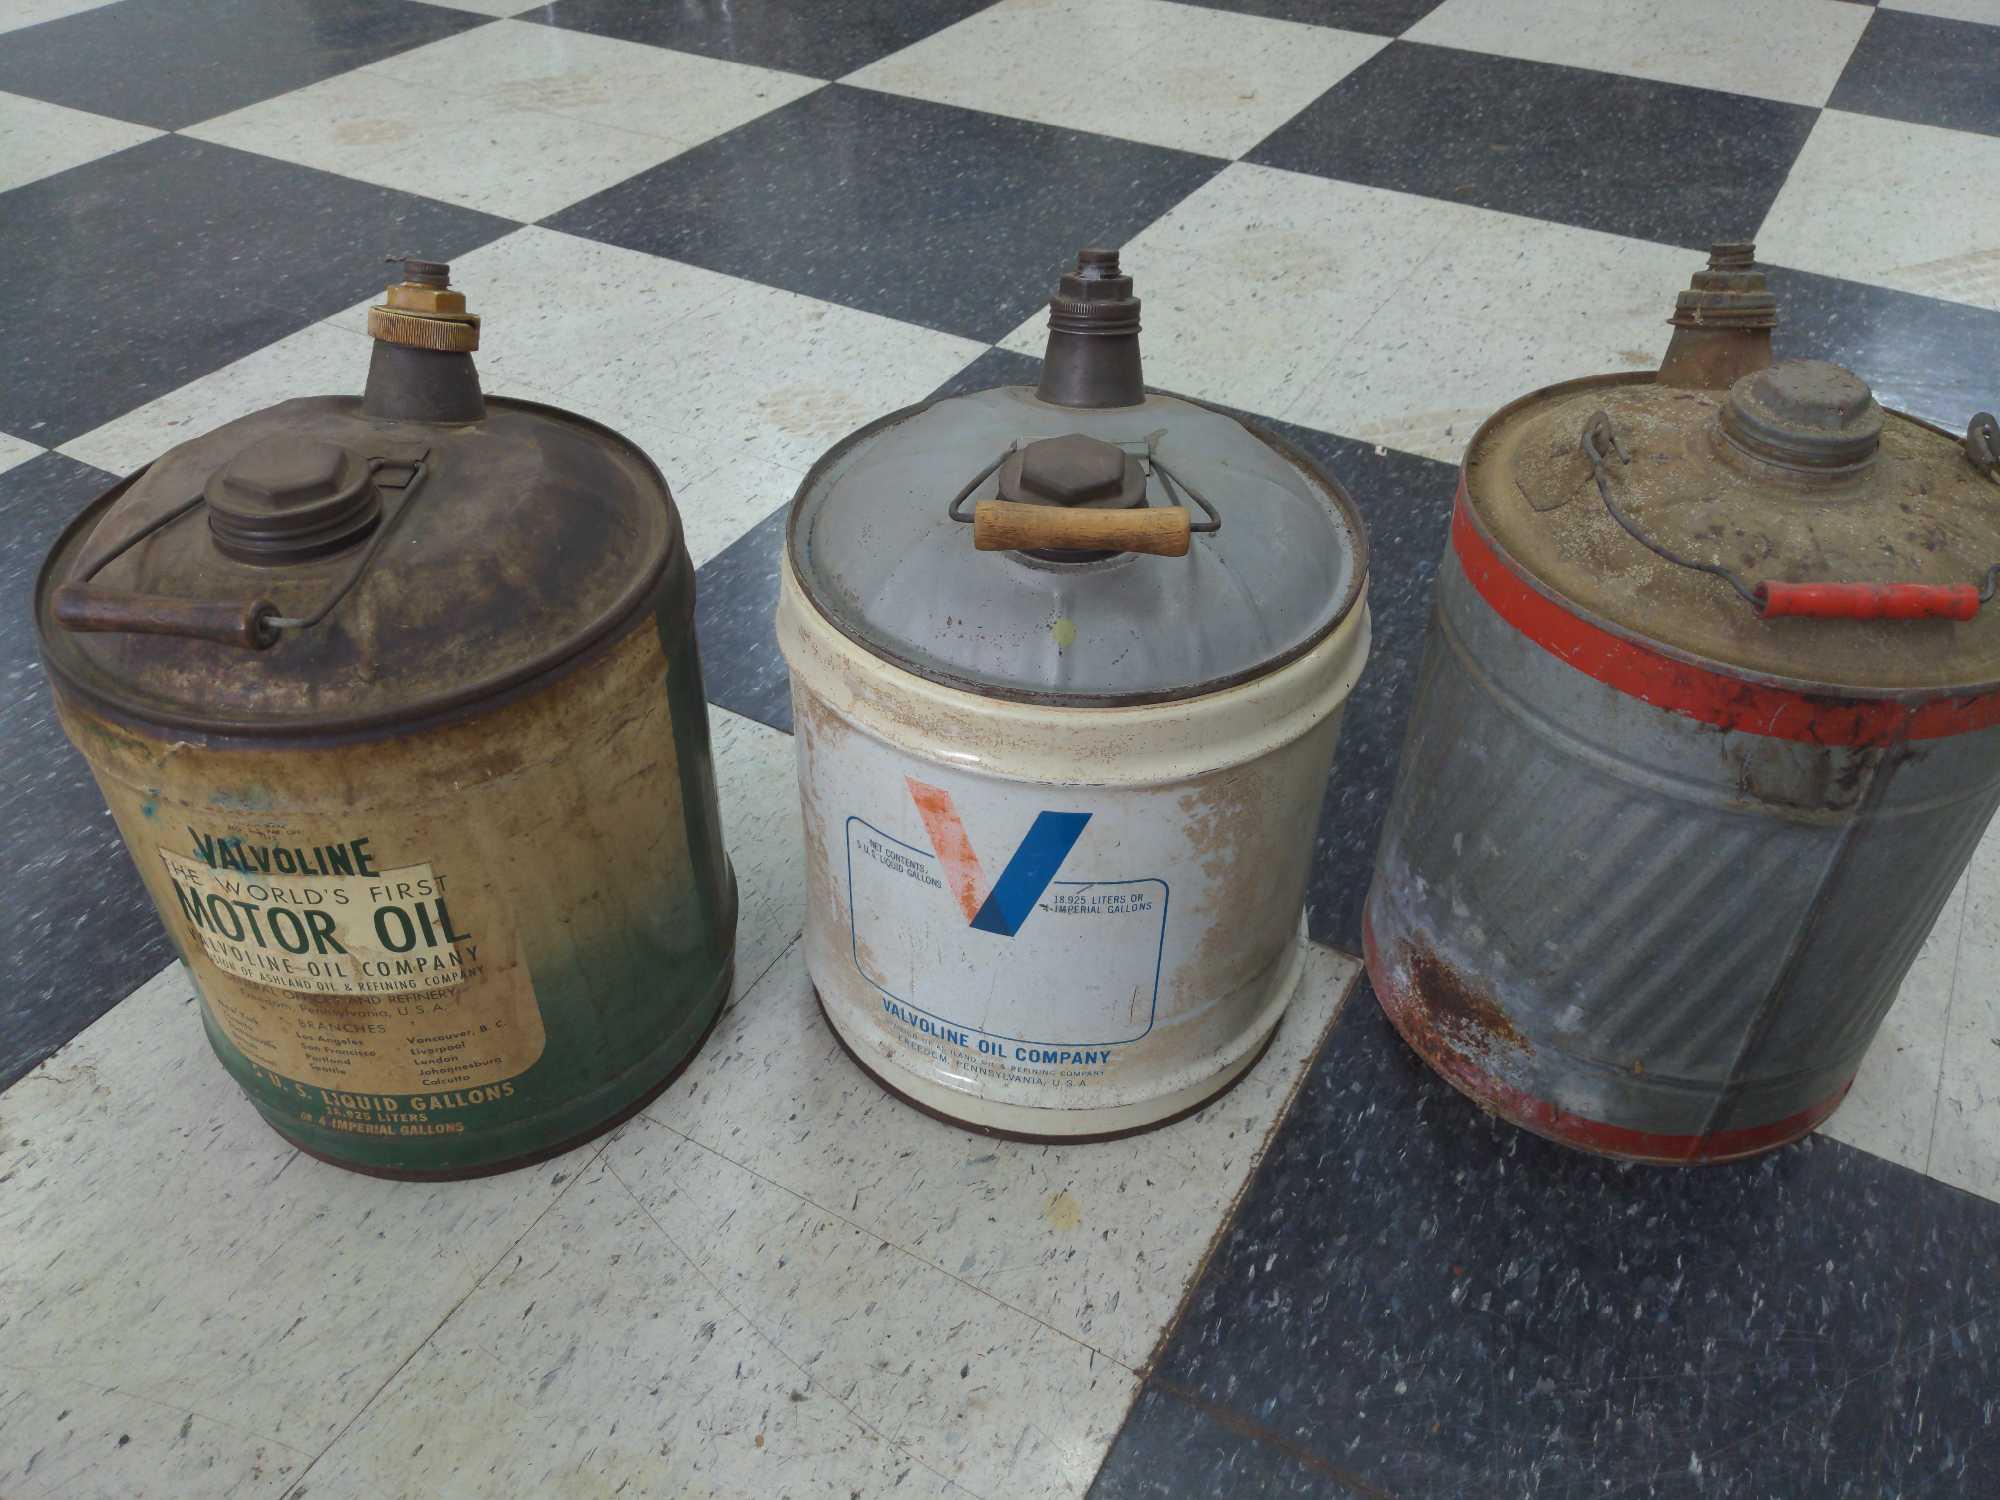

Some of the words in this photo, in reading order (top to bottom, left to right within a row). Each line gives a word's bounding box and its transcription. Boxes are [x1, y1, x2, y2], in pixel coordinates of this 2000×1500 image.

[187, 825, 380, 878] VALVOLINE
[214, 876, 350, 905] WORLD'S
[370, 875, 448, 903] FIRST
[906, 869, 942, 889] GALLONS
[1054, 904, 1102, 914] IMPERIAL
[1107, 902, 1152, 914] GALLONS
[1092, 895, 1126, 905] LITERS
[173, 879, 348, 955] MOTOR
[374, 896, 473, 953] OIL
[307, 961, 348, 978] OIL
[363, 945, 479, 977] COMPANY
[259, 972, 311, 991] ASHLAND
[316, 980, 336, 993] OIL
[344, 982, 352, 992] &
[358, 979, 418, 992] REFINING
[424, 966, 484, 987] COMPANY
[297, 1018, 386, 1035] BRANCHES
[882, 997, 969, 1049] VALVOLINE
[978, 1040, 1008, 1058] OIL
[1015, 1046, 1112, 1065] COMPANY
[320, 1088, 399, 1113] LIQUID
[411, 1082, 515, 1112] GALLONS
[332, 1117, 396, 1137] IMPERIAL
[400, 1121, 465, 1137] GALLONS
[377, 1111, 428, 1123] LITERS
